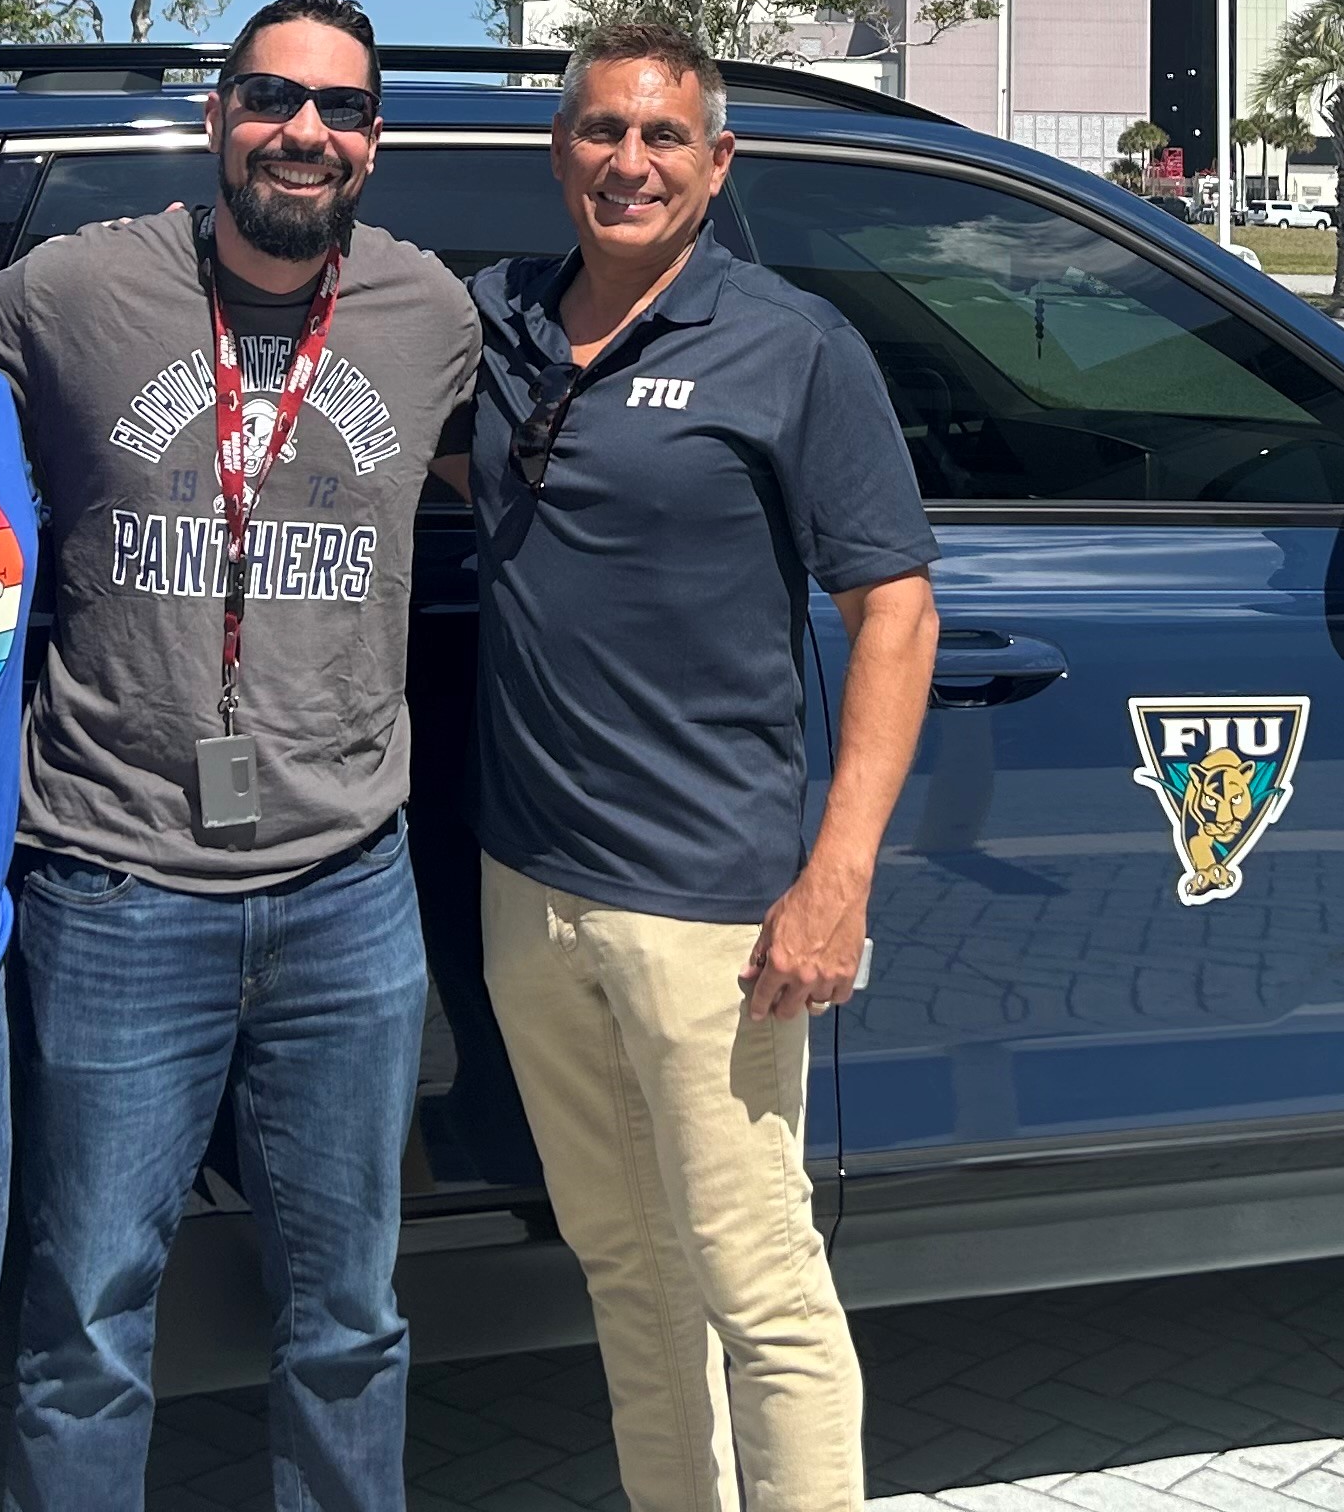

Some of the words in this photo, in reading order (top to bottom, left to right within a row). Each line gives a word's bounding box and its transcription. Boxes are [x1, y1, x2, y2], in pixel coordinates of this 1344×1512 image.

[109, 349, 218, 463] FLORIDA
[625, 377, 696, 410] FIU
[169, 469, 198, 503] 19
[307, 475, 339, 509] 72
[1159, 717, 1284, 757] FIU
